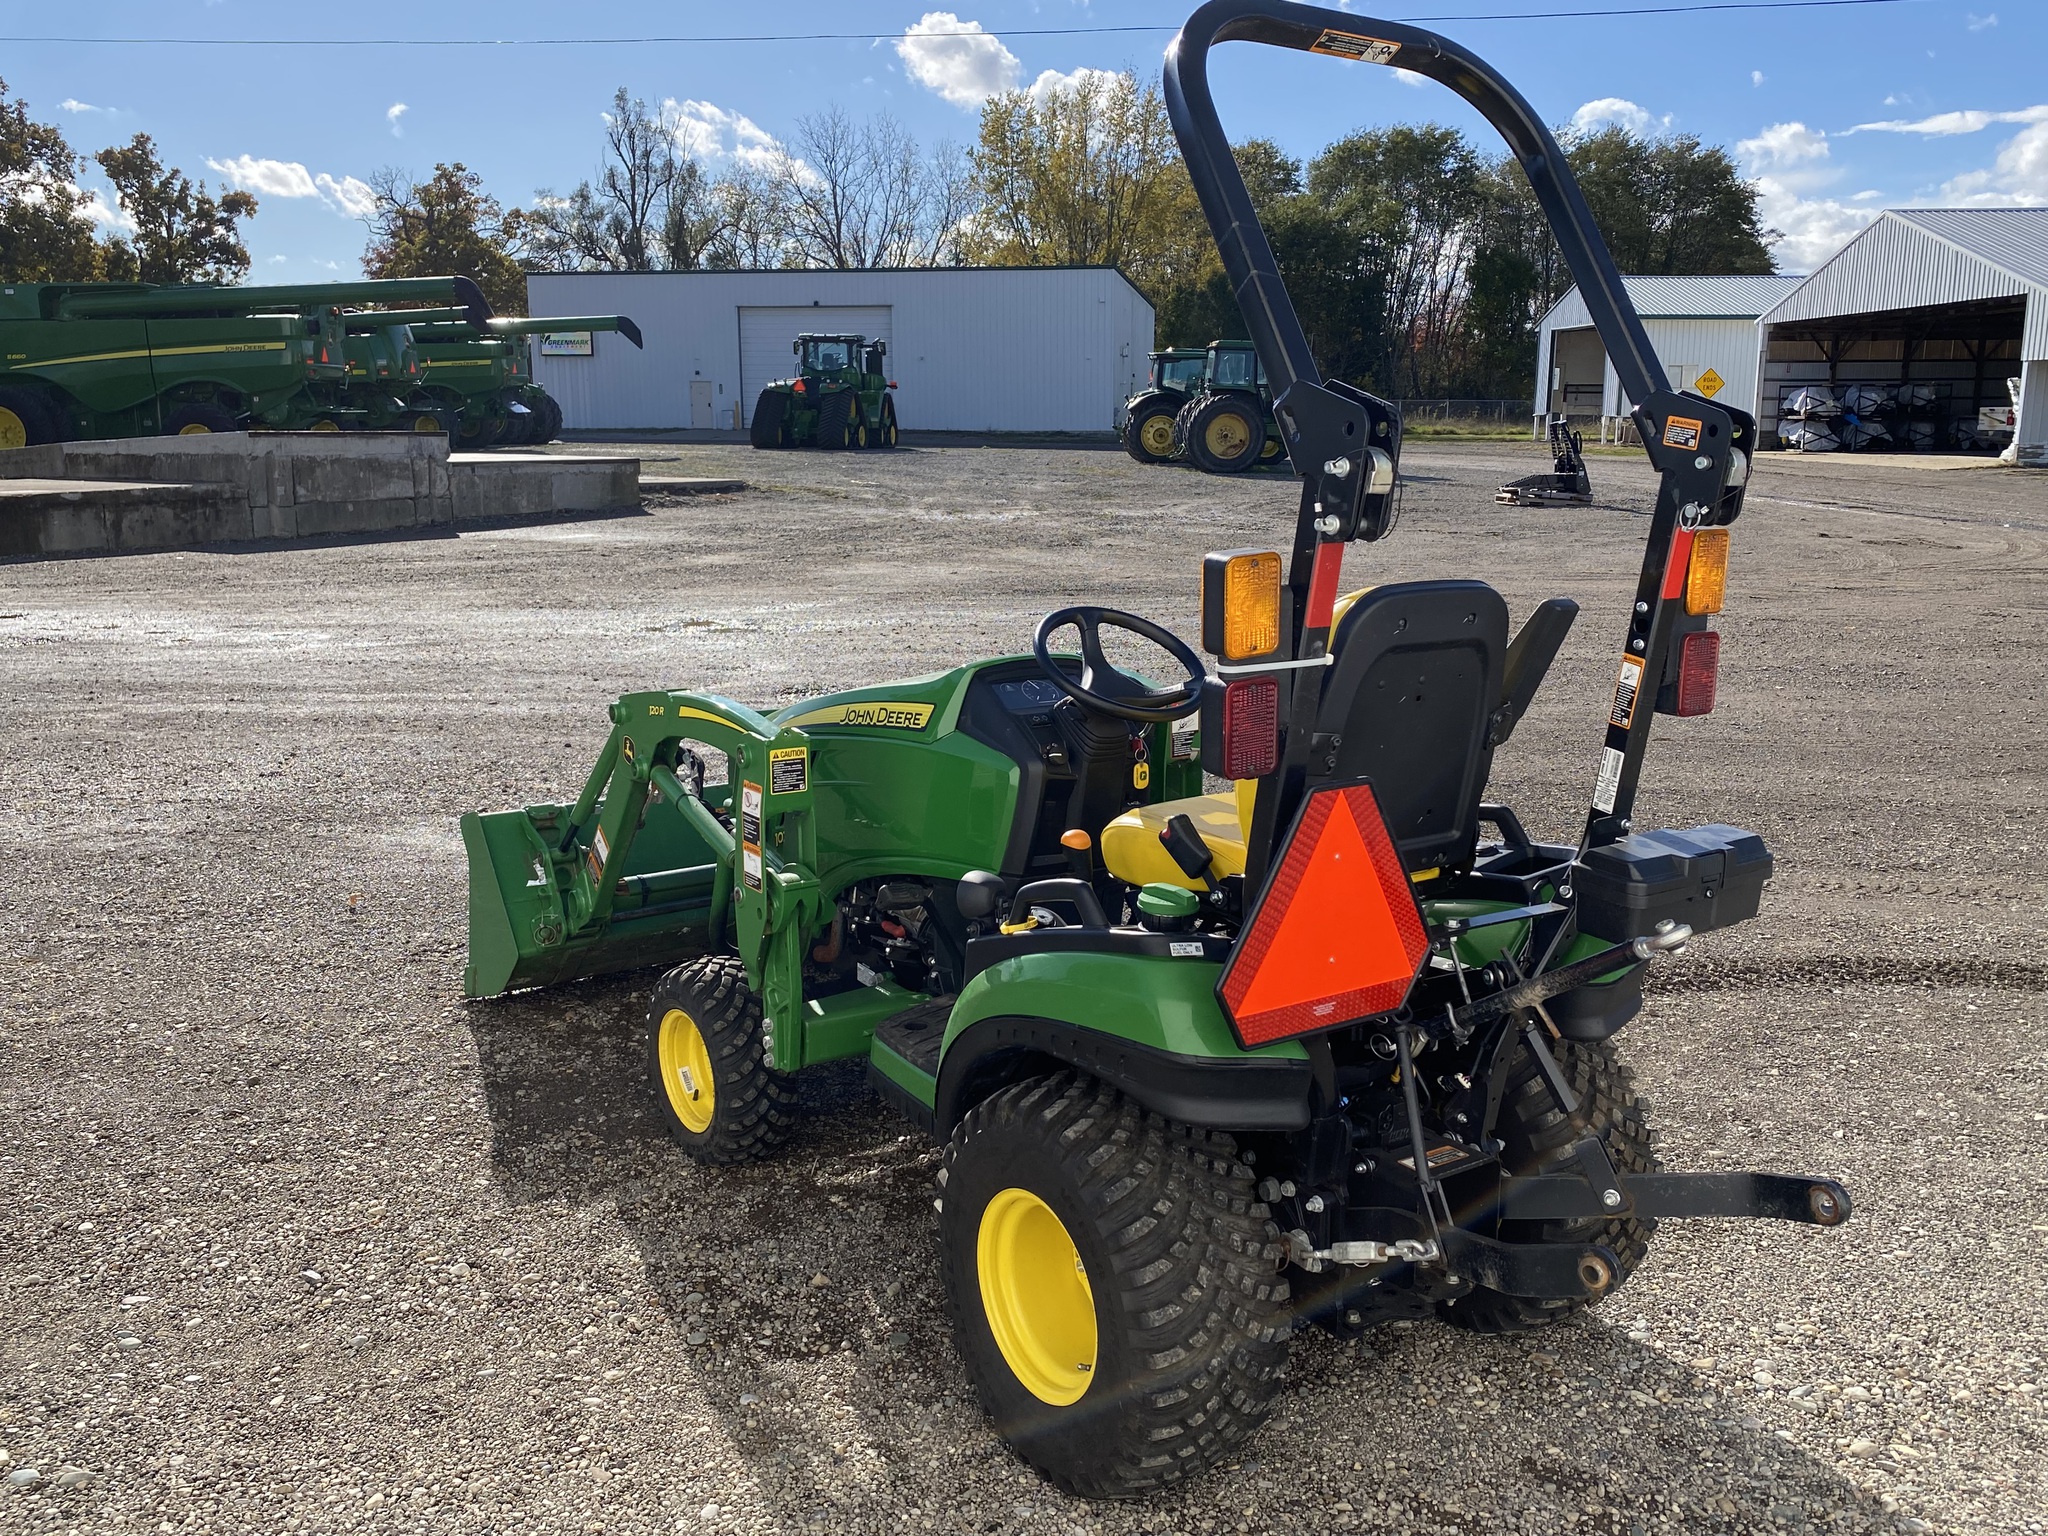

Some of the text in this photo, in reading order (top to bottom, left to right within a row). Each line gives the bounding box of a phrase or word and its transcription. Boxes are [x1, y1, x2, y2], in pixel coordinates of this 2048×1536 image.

[1676, 419, 1699, 429] WARNING
[840, 707, 923, 726] JOHN DEERE
[780, 749, 805, 759] CAUTION
